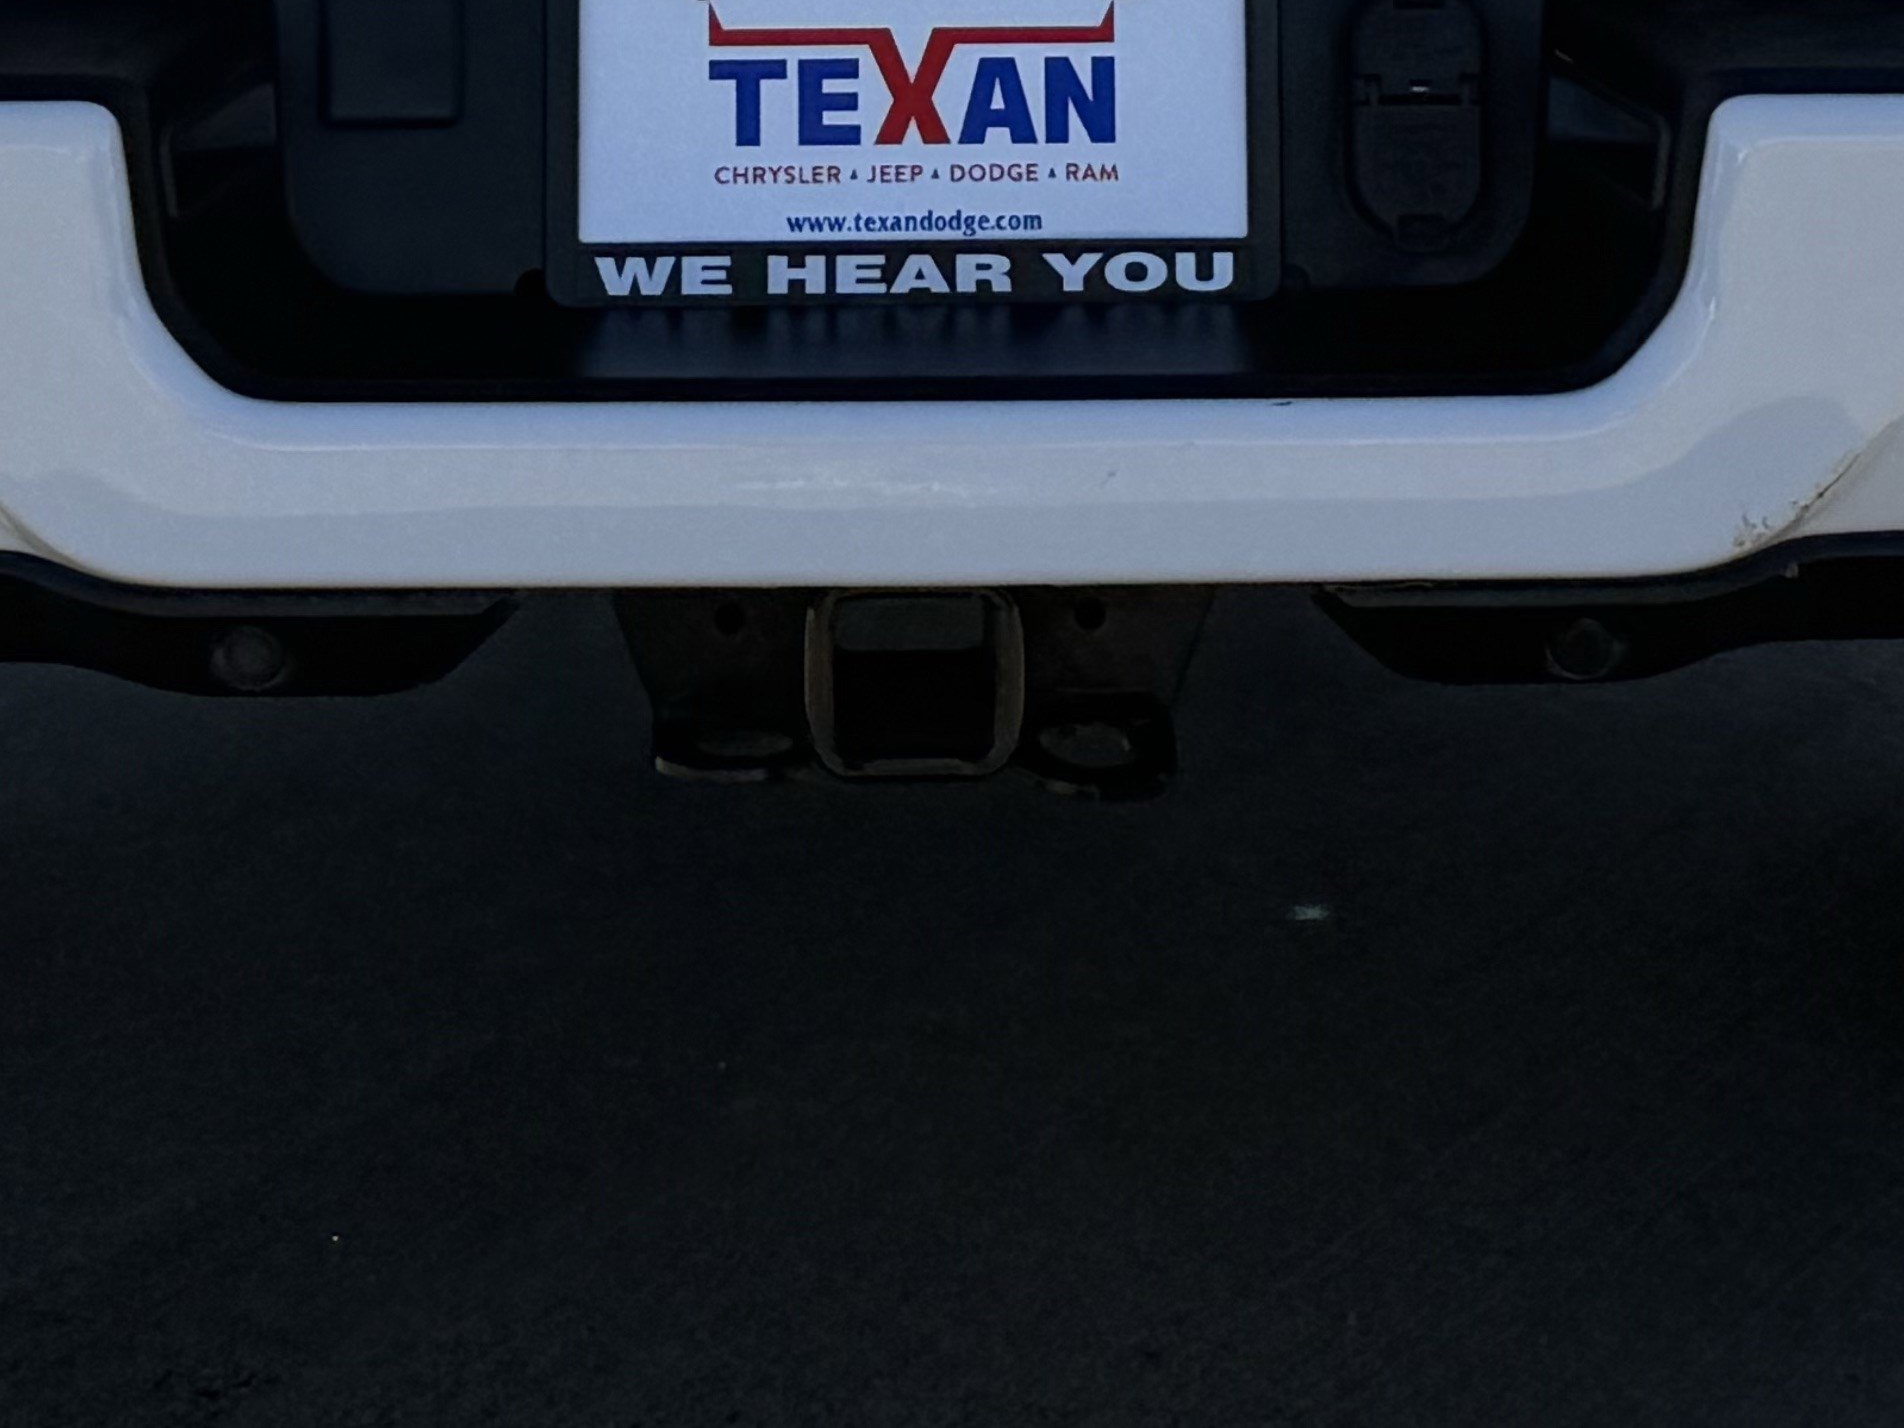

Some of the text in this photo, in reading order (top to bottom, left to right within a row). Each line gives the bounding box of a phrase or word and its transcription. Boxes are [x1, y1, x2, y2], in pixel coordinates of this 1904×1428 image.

[708, 24, 1117, 147] TEXAN
[713, 162, 1120, 185] CHRYSLER JEEP DODGE RAM
[786, 209, 1043, 237] www.texandodge.com
[594, 250, 1236, 297] WE HEAR YOU
